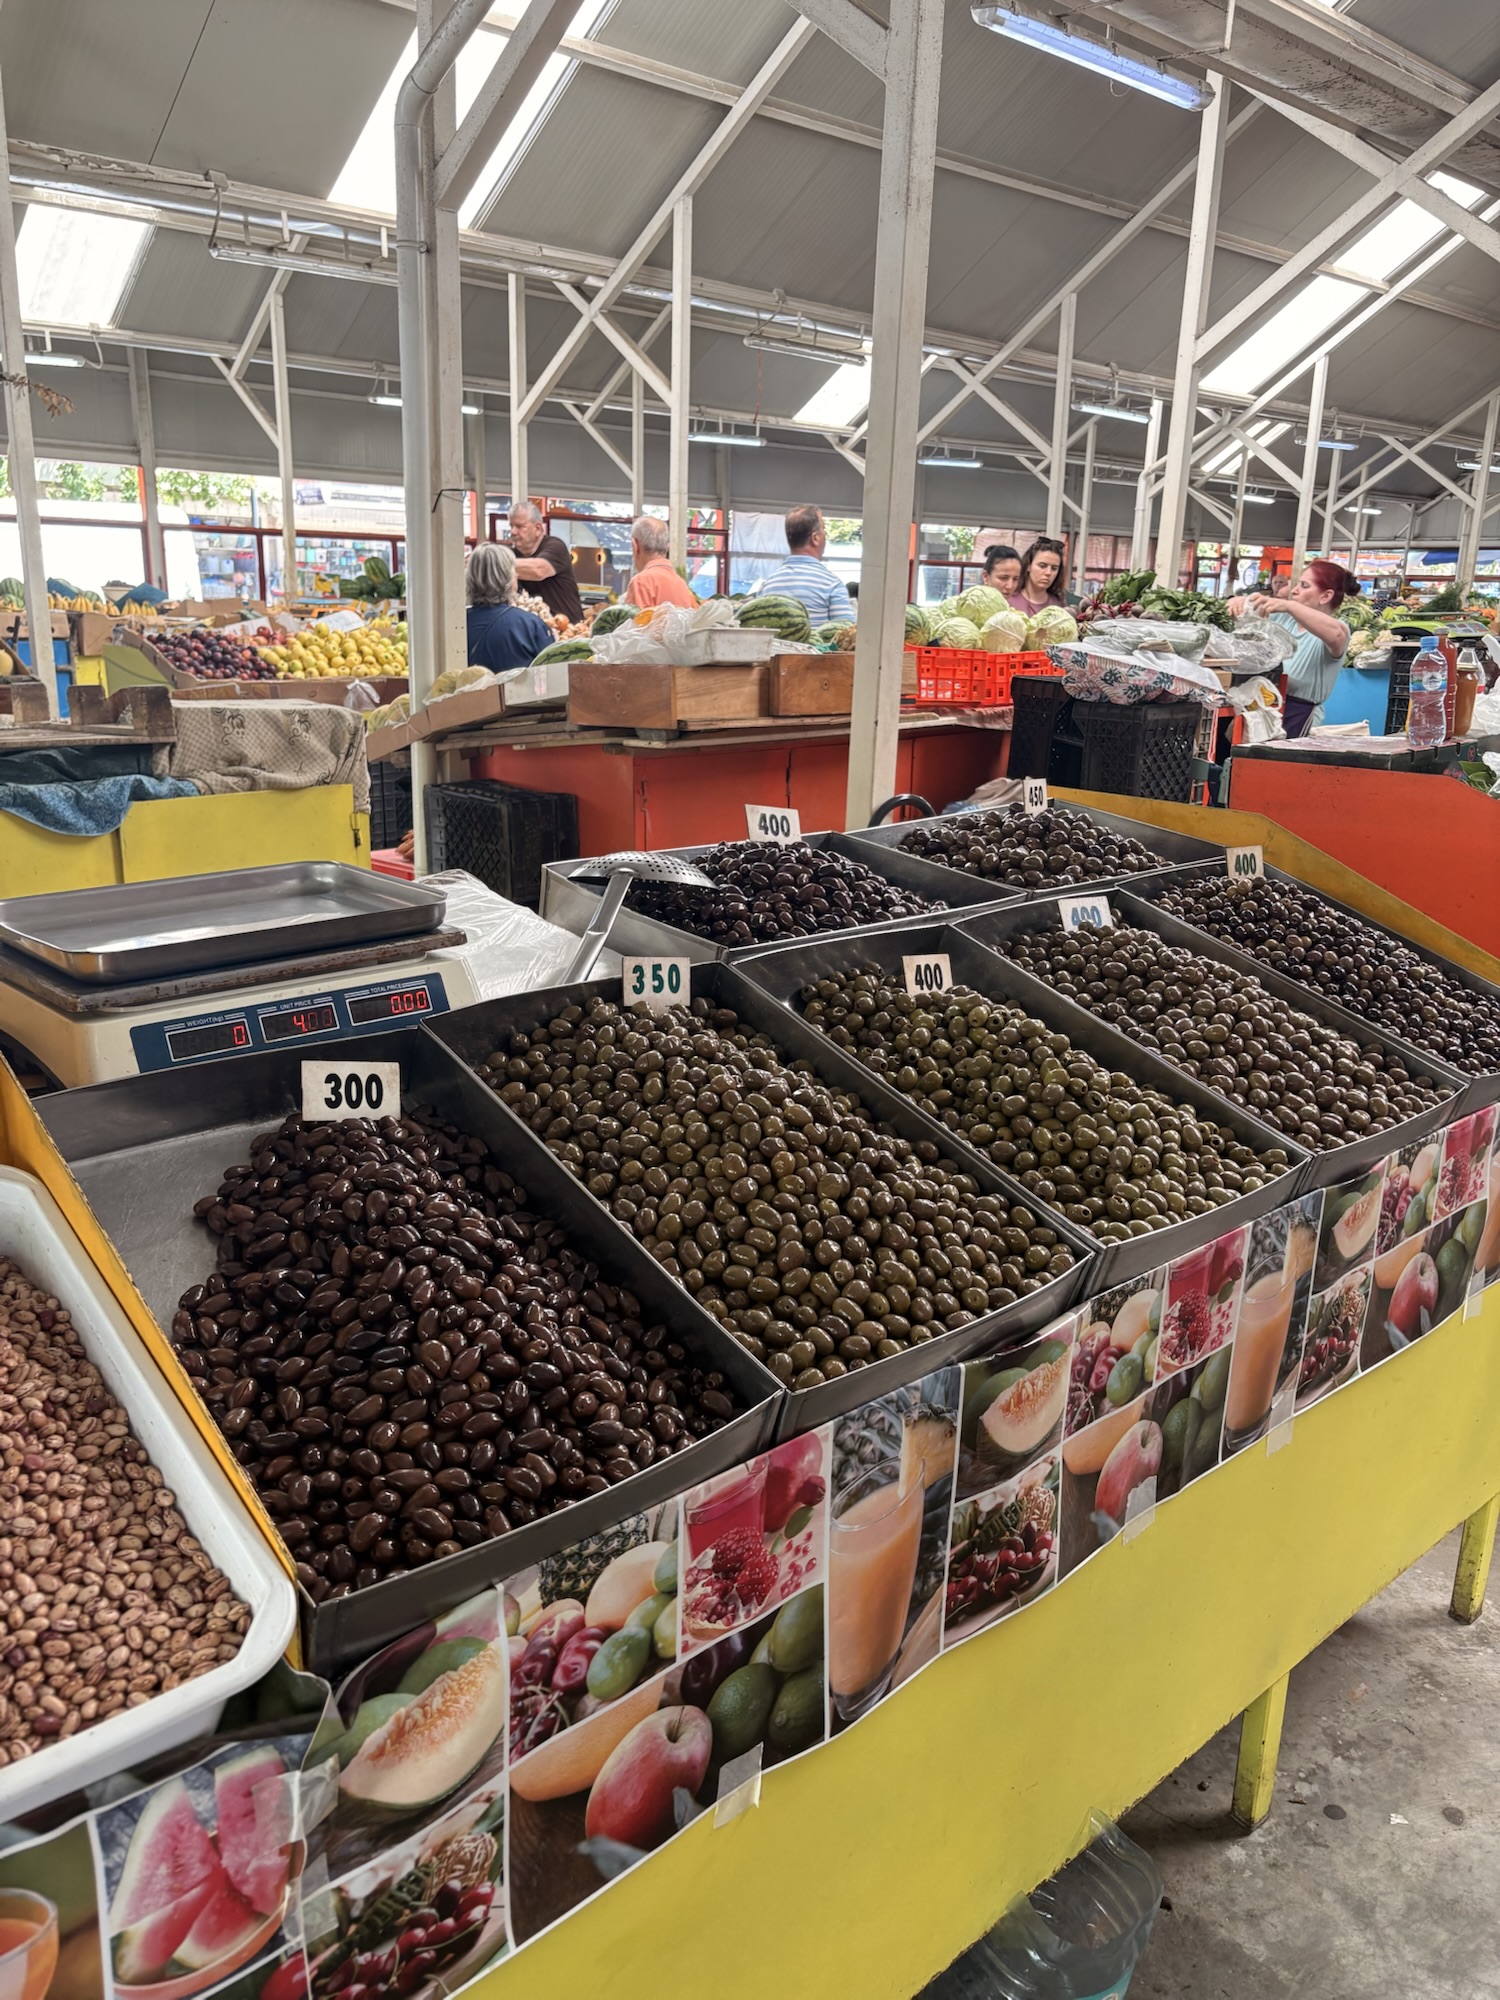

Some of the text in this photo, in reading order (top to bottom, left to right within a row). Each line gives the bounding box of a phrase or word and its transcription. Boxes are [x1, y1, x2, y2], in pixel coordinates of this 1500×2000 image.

[1029, 785, 1043, 807] 450
[758, 813, 790, 837] 400
[1235, 853, 1256, 875] 400
[1071, 906, 1102, 928] 400
[632, 963, 680, 995] 350
[915, 963, 943, 990] 400
[370, 983, 402, 994] TOTAL PRICE
[280, 999, 312, 1010] UNIT PRICE
[390, 991, 427, 1014] 0.00
[293, 1008, 333, 1033] 4.00
[233, 1025, 246, 1045] 0
[324, 1073, 383, 1109] 300
